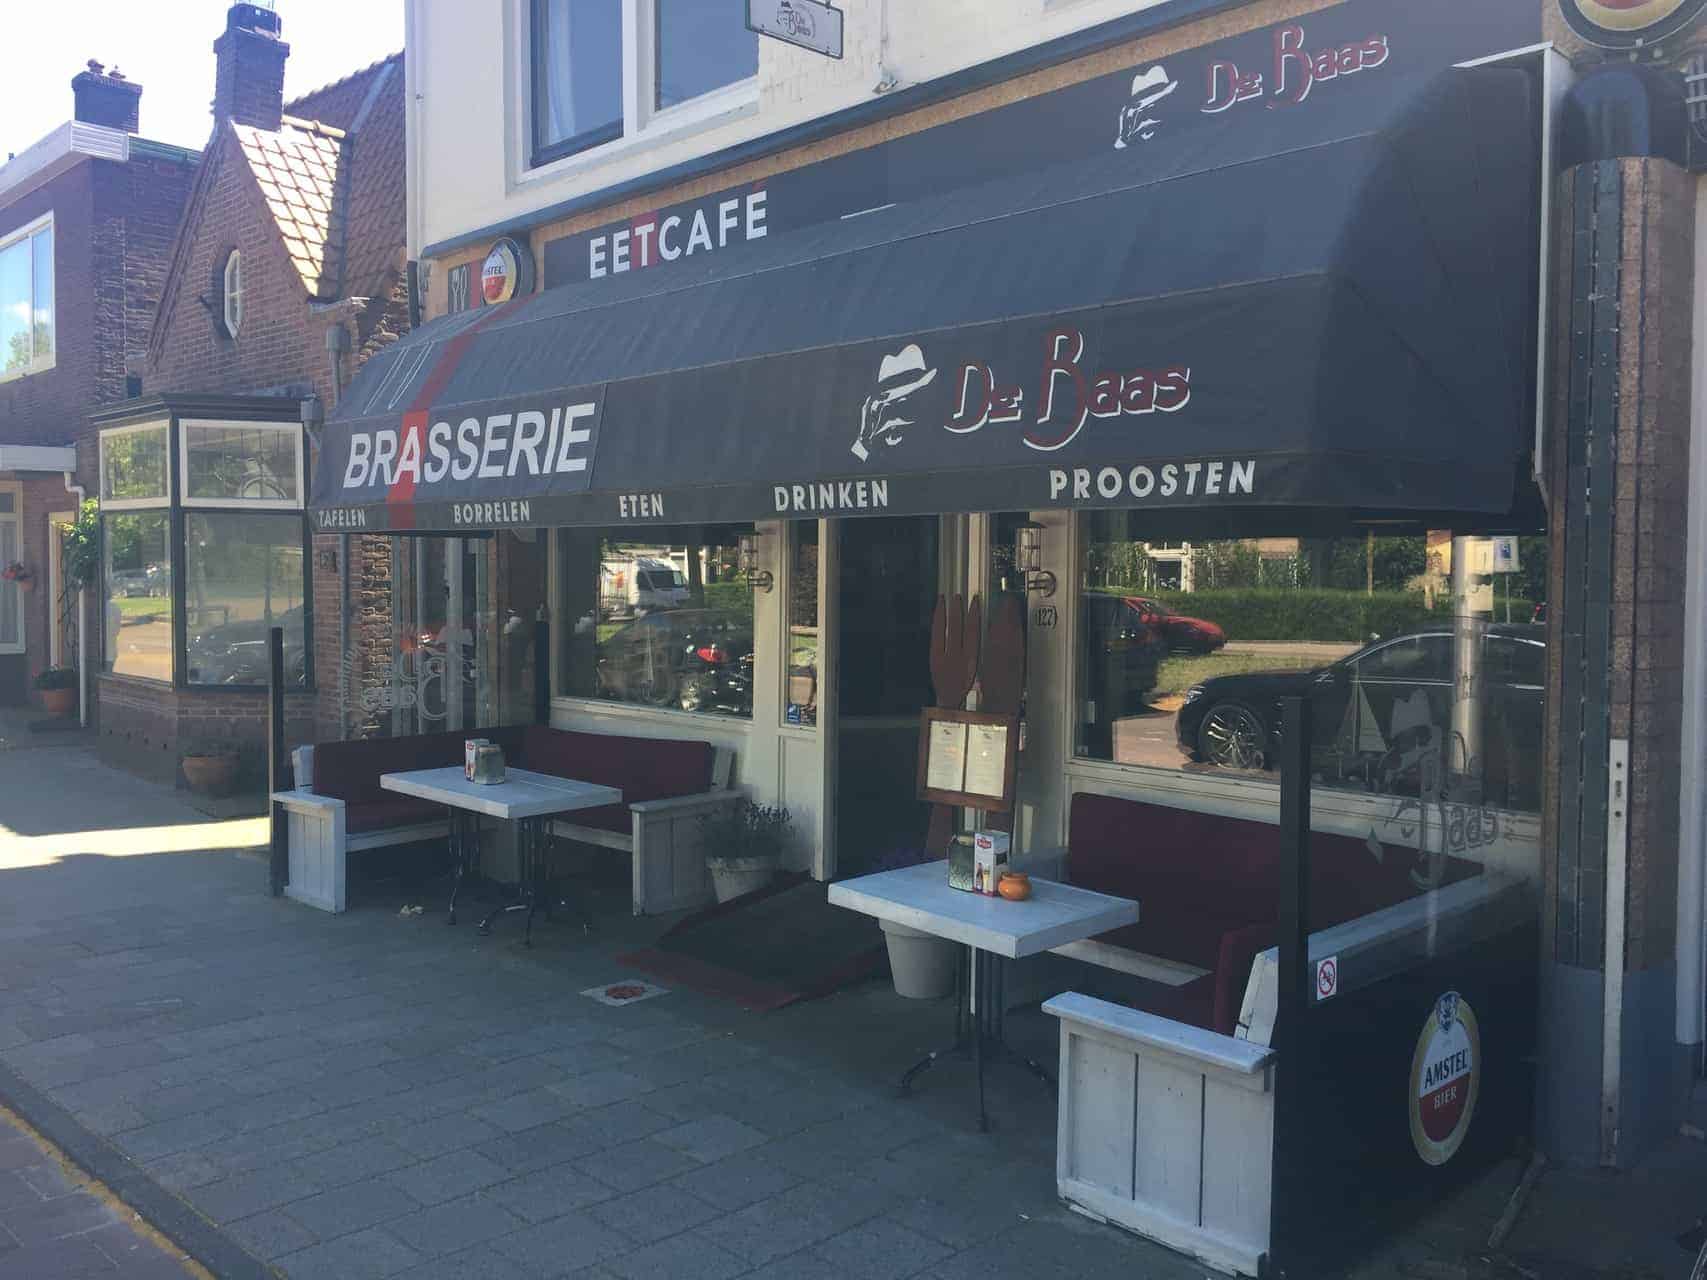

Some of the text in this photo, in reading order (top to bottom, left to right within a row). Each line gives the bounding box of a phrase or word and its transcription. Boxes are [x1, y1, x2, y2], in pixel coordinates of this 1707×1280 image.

[1200, 25, 1389, 113] De Baas
[590, 190, 767, 279] EETCAFE
[944, 330, 1191, 451] De Baas
[343, 402, 596, 489] BRASSERIE
[318, 459, 1256, 528] TAFELEN BORRELEN ETEN DRINKEN PROOSTEN
[1424, 1048, 1468, 1089] AMSTEL
[1433, 1087, 1457, 1110] BIER
